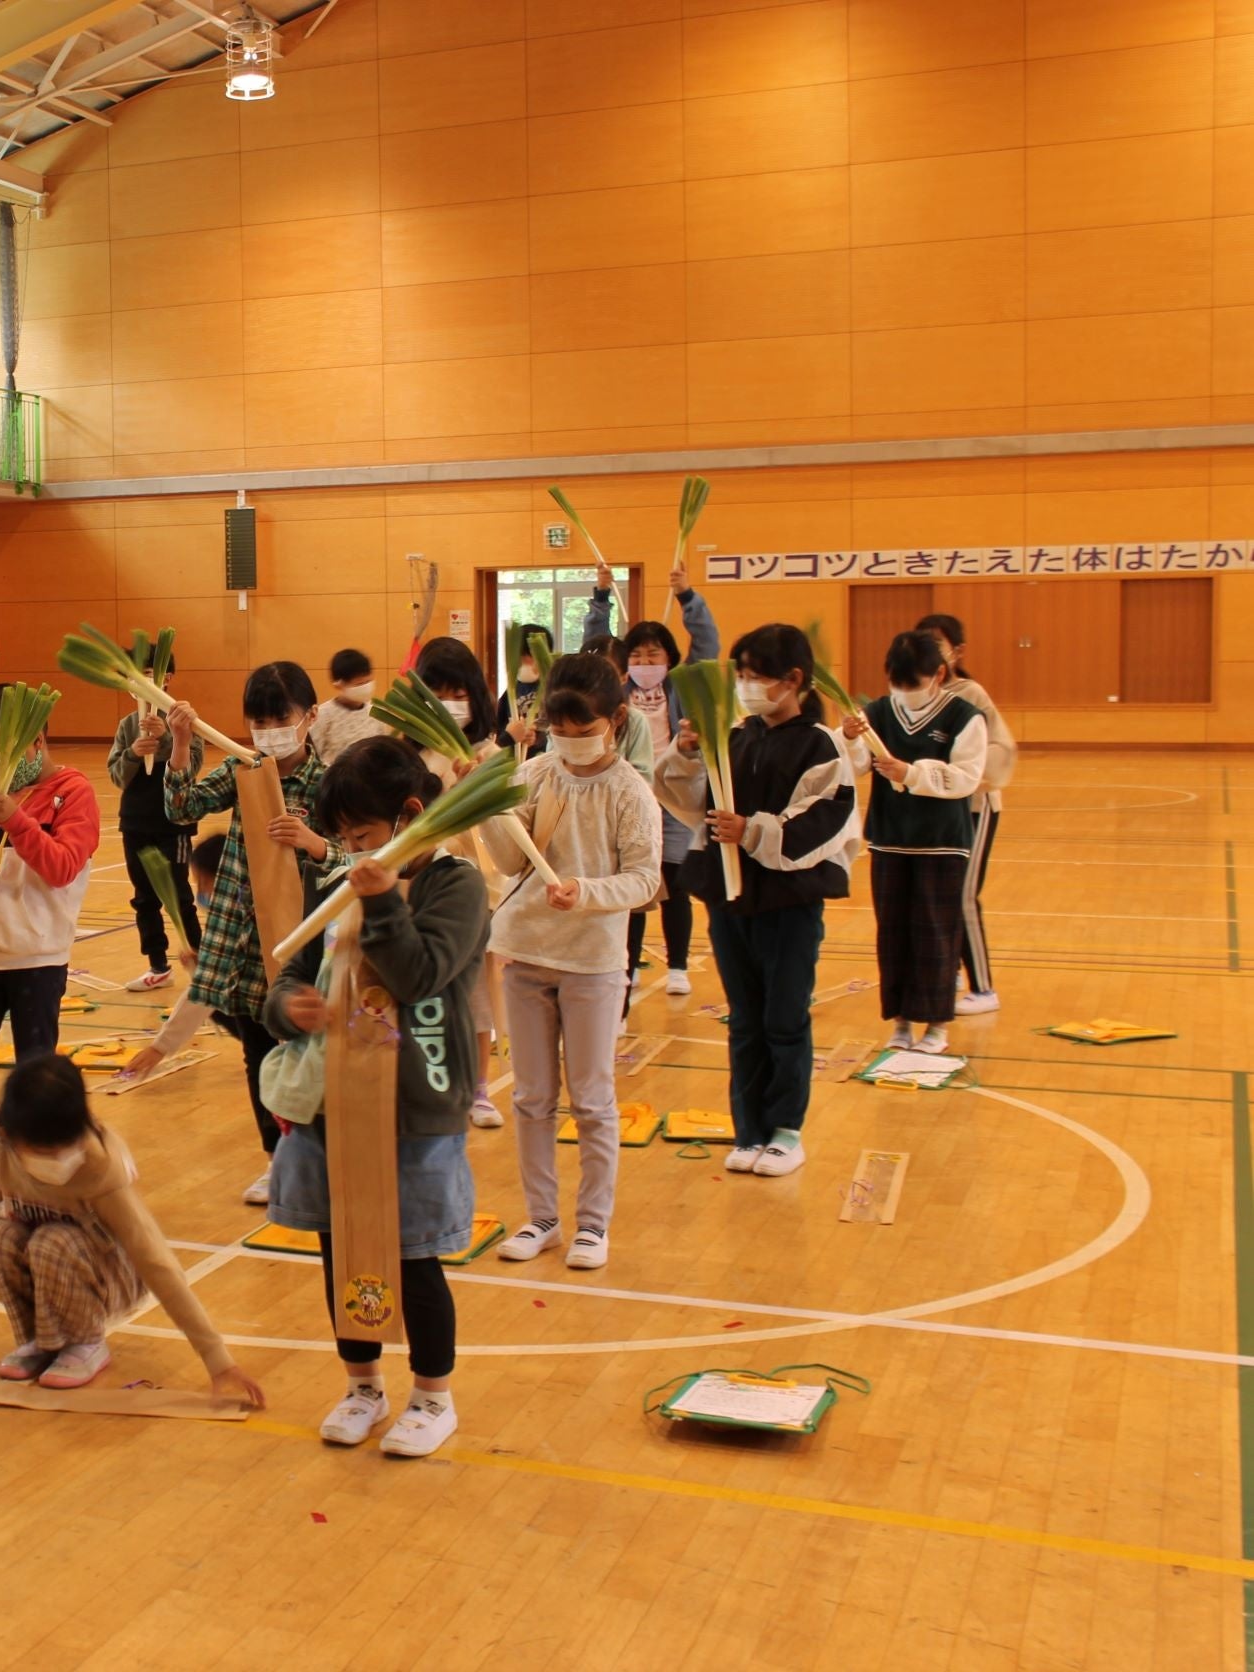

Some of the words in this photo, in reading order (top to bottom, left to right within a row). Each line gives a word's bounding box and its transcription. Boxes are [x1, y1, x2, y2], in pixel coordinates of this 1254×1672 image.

[708, 543, 1254, 580] コツコツときたえた体はたか
[410, 997, 450, 1093] adid
